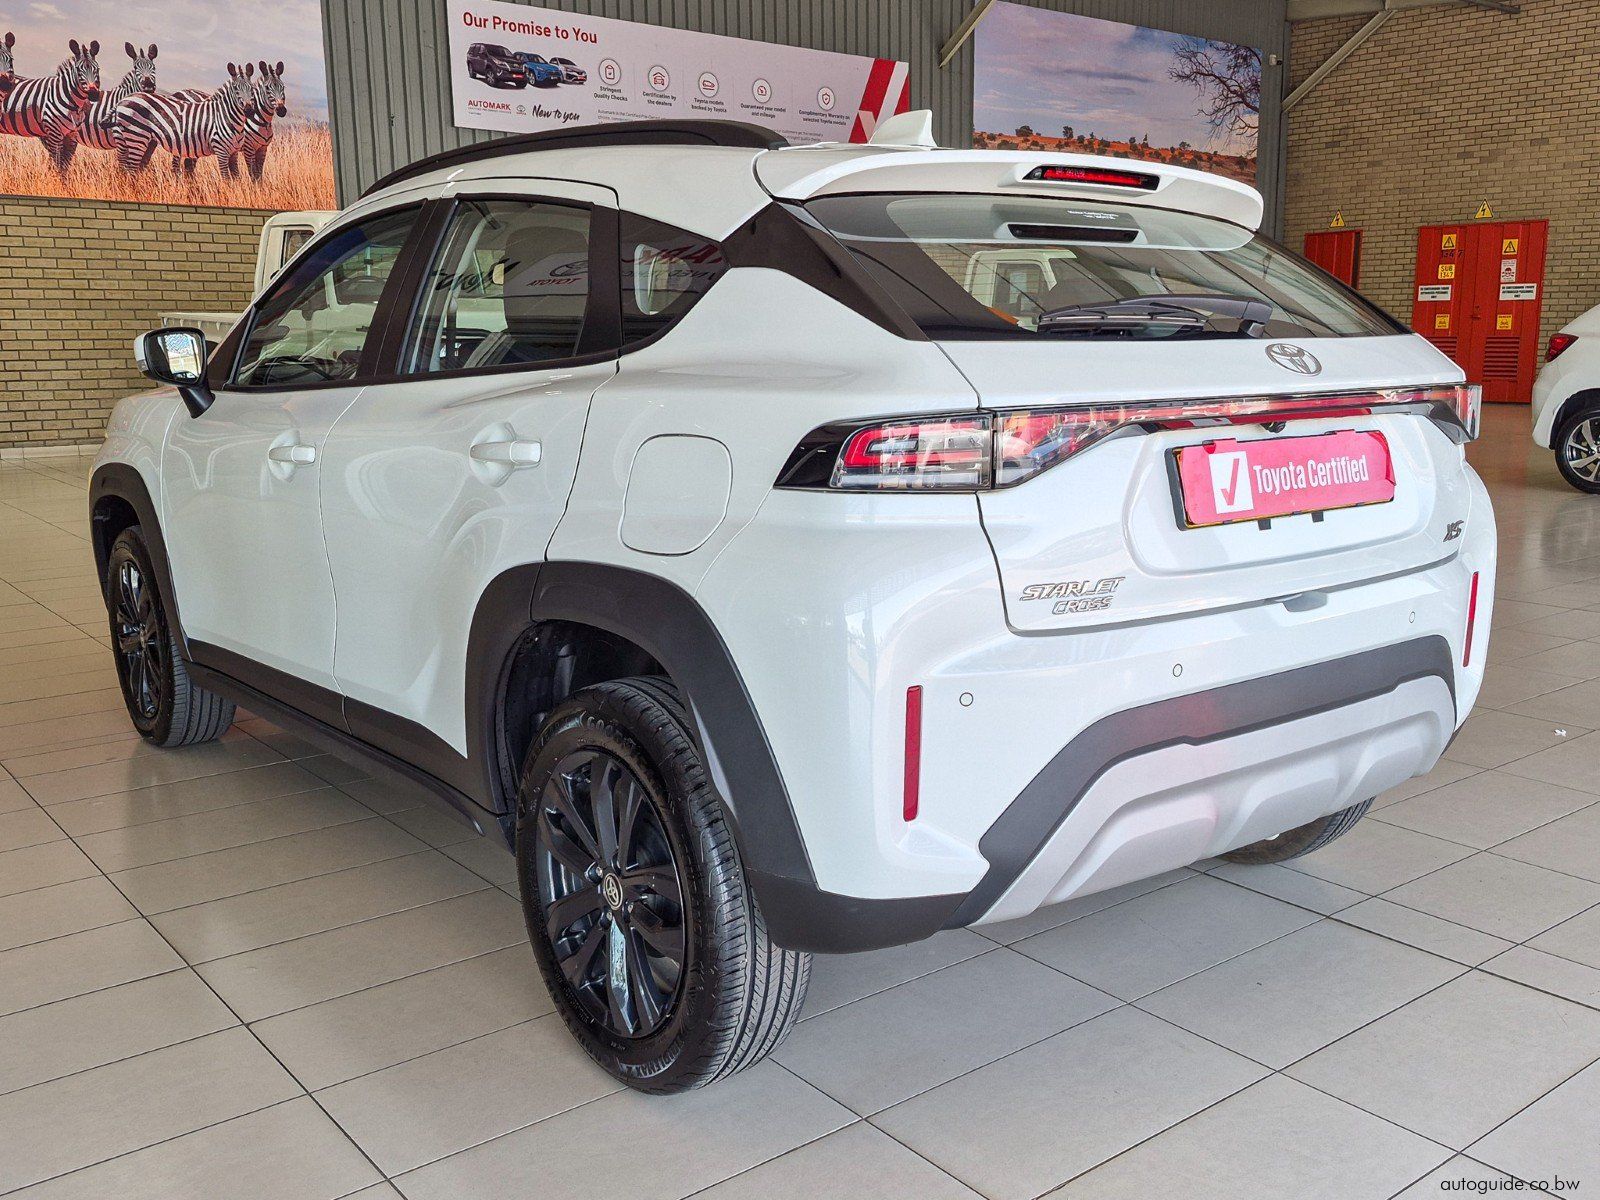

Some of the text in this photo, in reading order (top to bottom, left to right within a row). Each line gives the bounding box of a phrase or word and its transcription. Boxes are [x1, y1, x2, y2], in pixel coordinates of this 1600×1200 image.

[463, 12, 597, 44] Our Promise to You
[468, 99, 511, 111] AUTOMARK
[593, 92, 610, 100] Quality
[642, 91, 670, 99] Certification
[532, 104, 552, 118] New
[554, 108, 563, 118] to
[562, 112, 580, 123] you
[1253, 454, 1369, 496] Toyota Certified
[1442, 519, 1465, 543] XS
[1019, 576, 1126, 601] STARLET
[1051, 595, 1114, 615] CROSS
